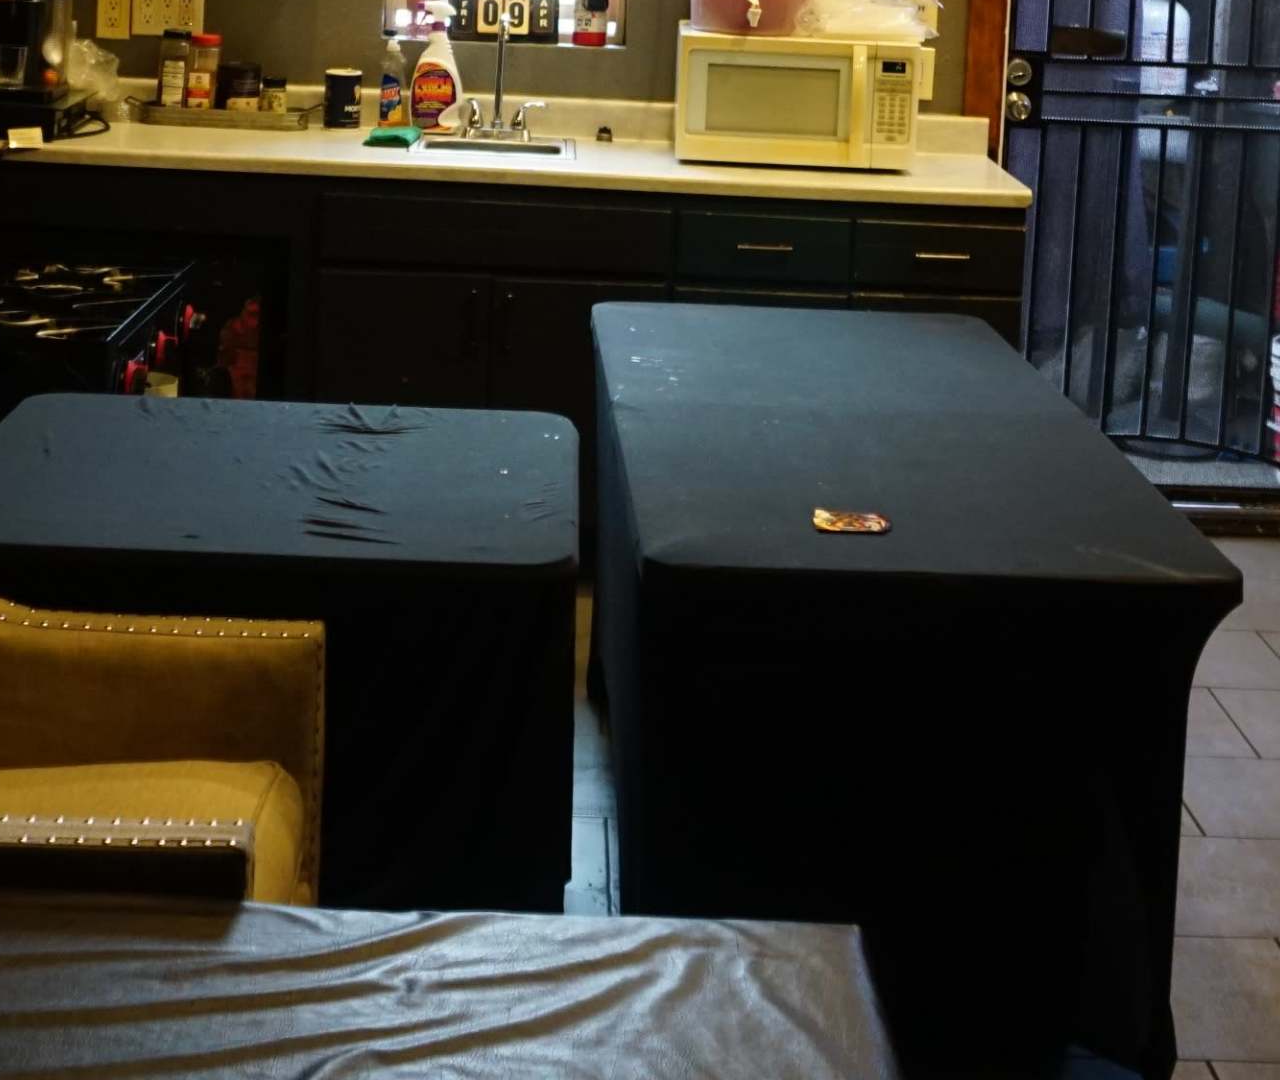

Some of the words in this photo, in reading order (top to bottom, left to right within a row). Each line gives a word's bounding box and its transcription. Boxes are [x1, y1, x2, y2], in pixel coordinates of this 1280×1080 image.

[459, 0, 468, 25] FRI
[483, 0, 524, 28] 09
[539, 0, 548, 28] APR
